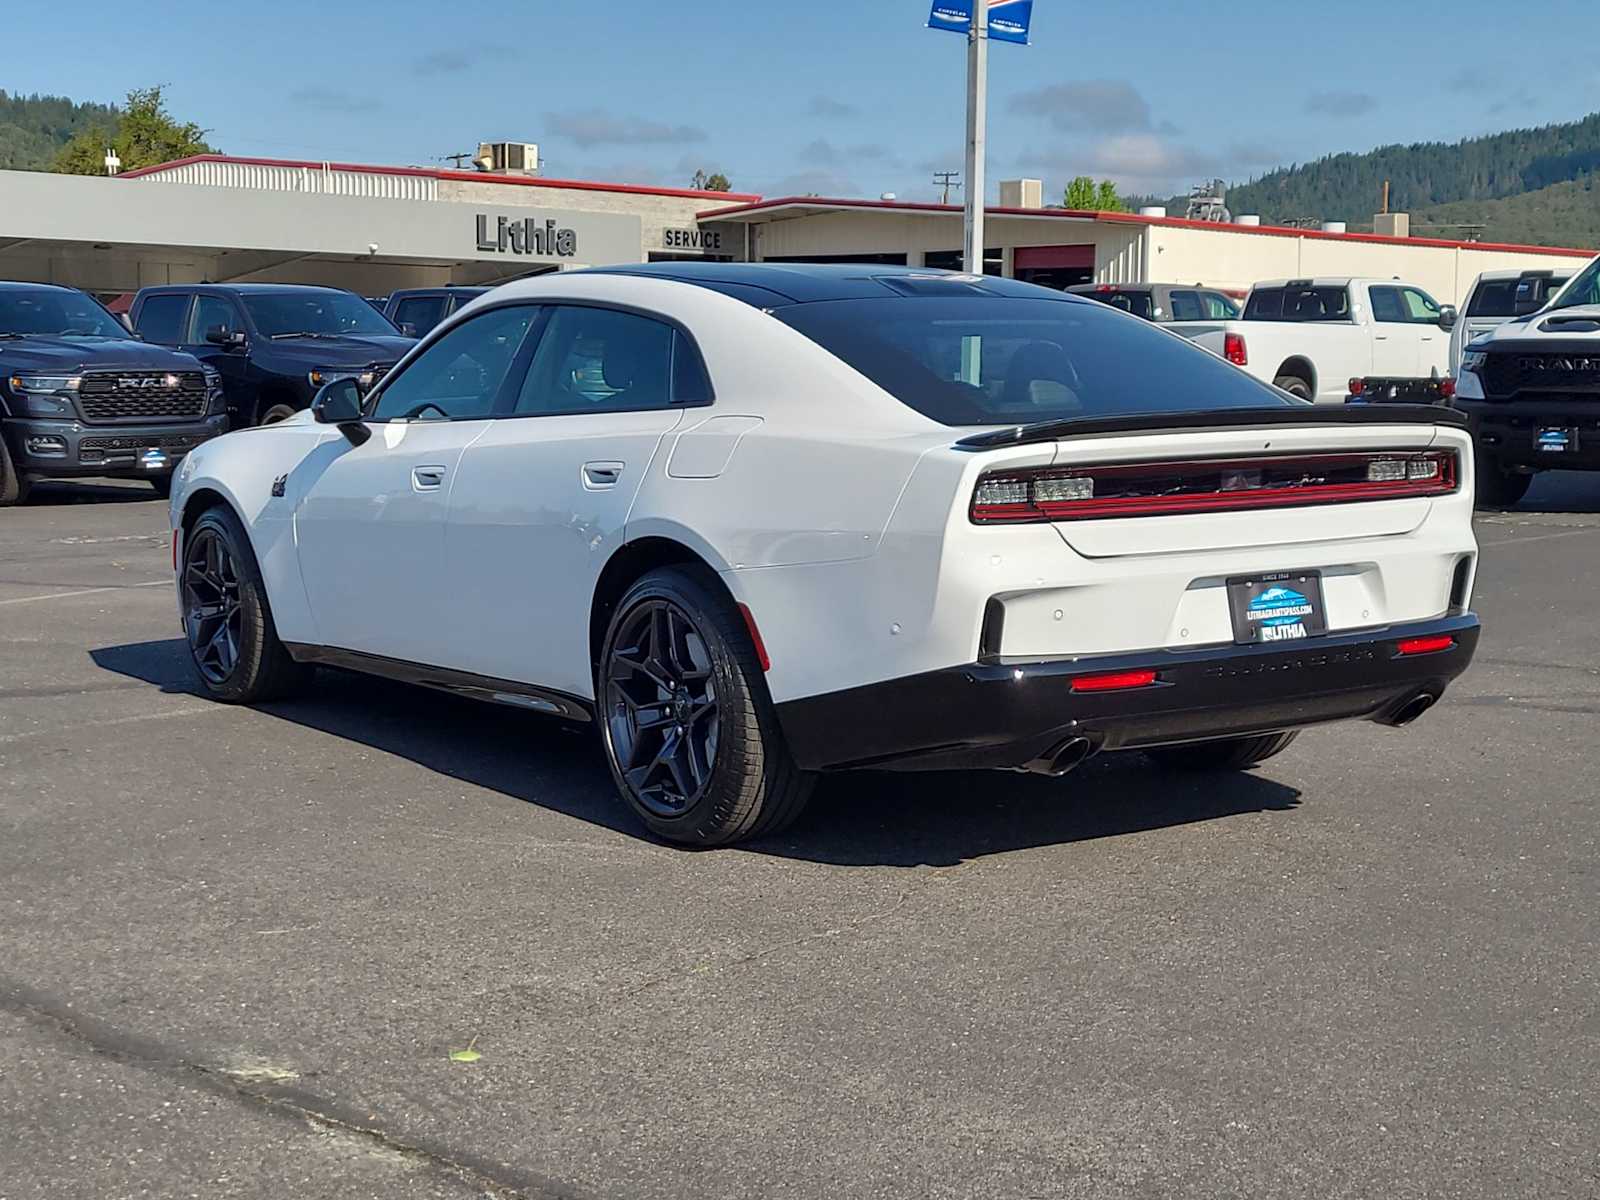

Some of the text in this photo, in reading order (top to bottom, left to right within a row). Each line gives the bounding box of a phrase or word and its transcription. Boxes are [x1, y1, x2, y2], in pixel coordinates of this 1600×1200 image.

[476, 214, 577, 256] Lithia
[665, 230, 721, 249] SERVICE
[1270, 623, 1308, 640] LITHIA
